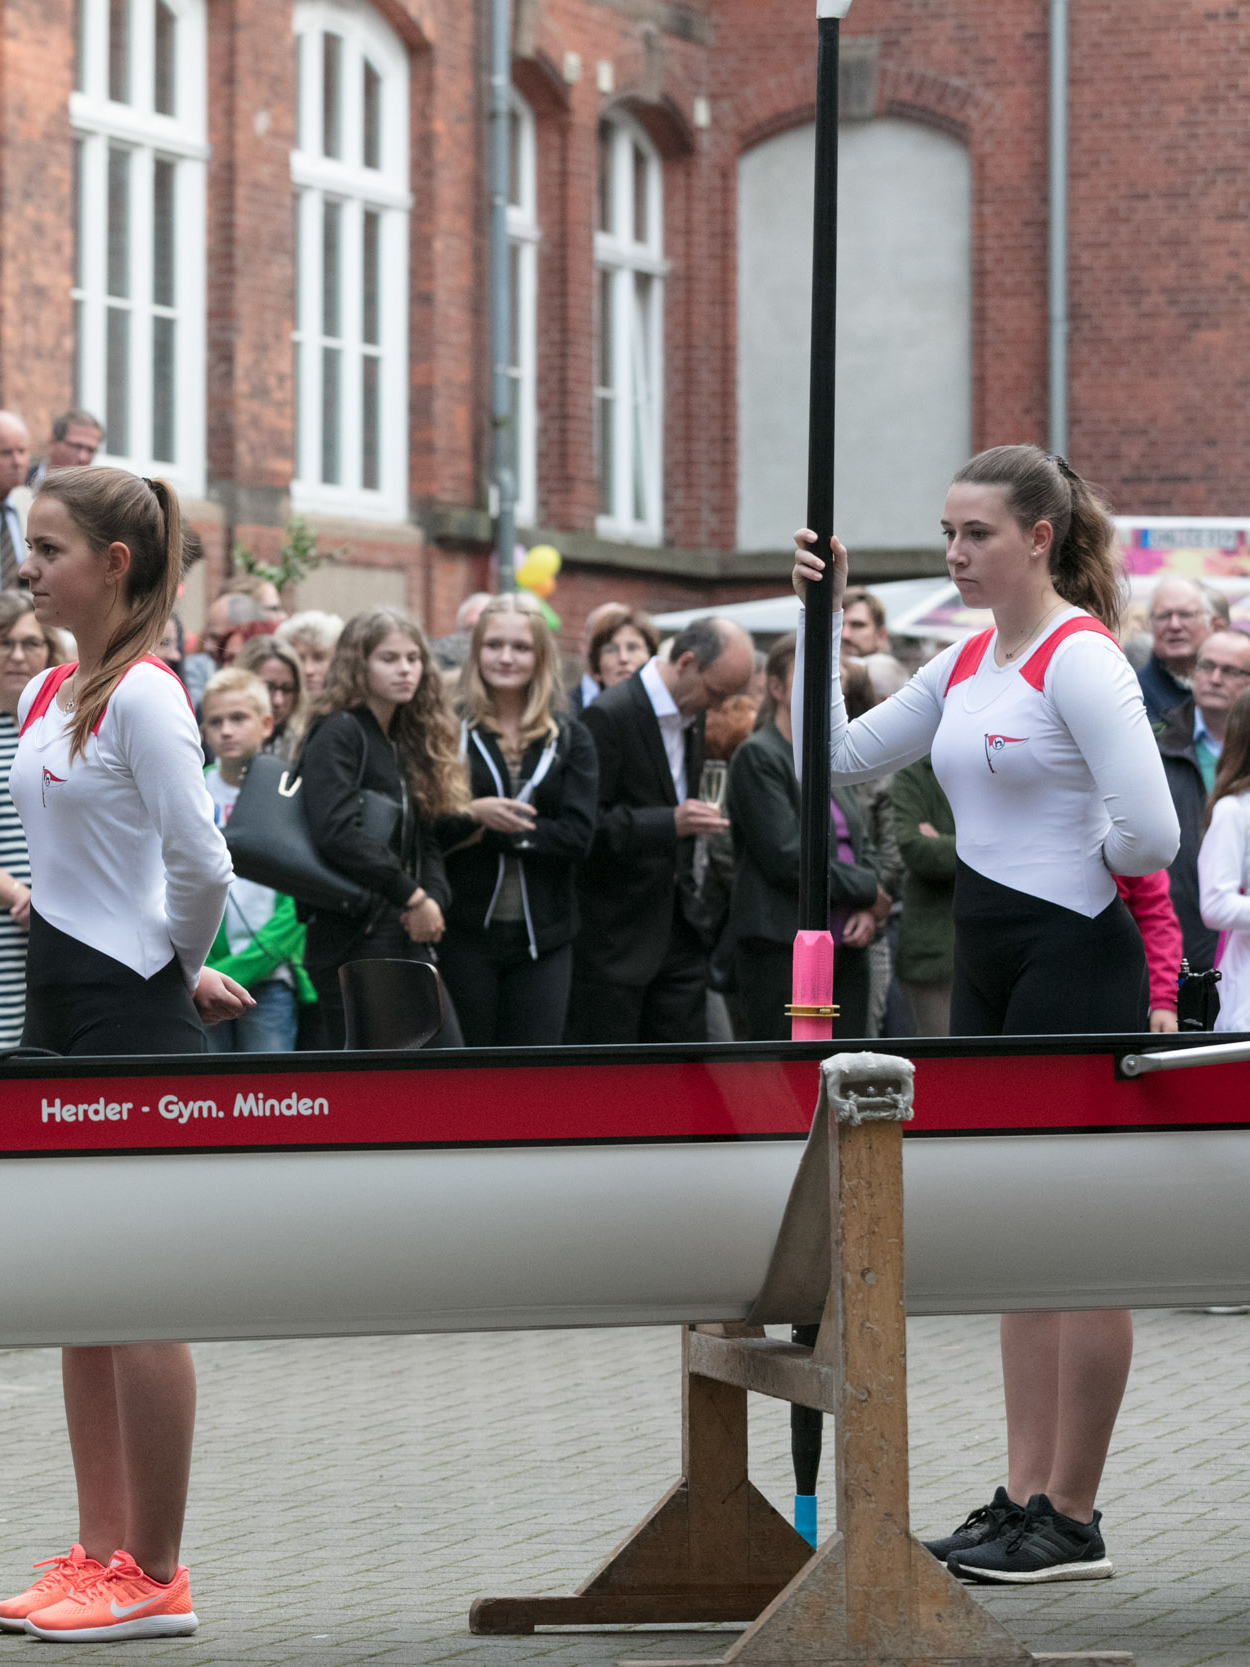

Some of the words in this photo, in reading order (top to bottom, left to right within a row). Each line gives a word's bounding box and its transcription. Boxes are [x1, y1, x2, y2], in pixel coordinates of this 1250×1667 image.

[41, 1097, 133, 1123] Herder
[141, 1105, 150, 1113] -
[158, 1094, 225, 1124] Gym.
[233, 1092, 329, 1117] Minden
